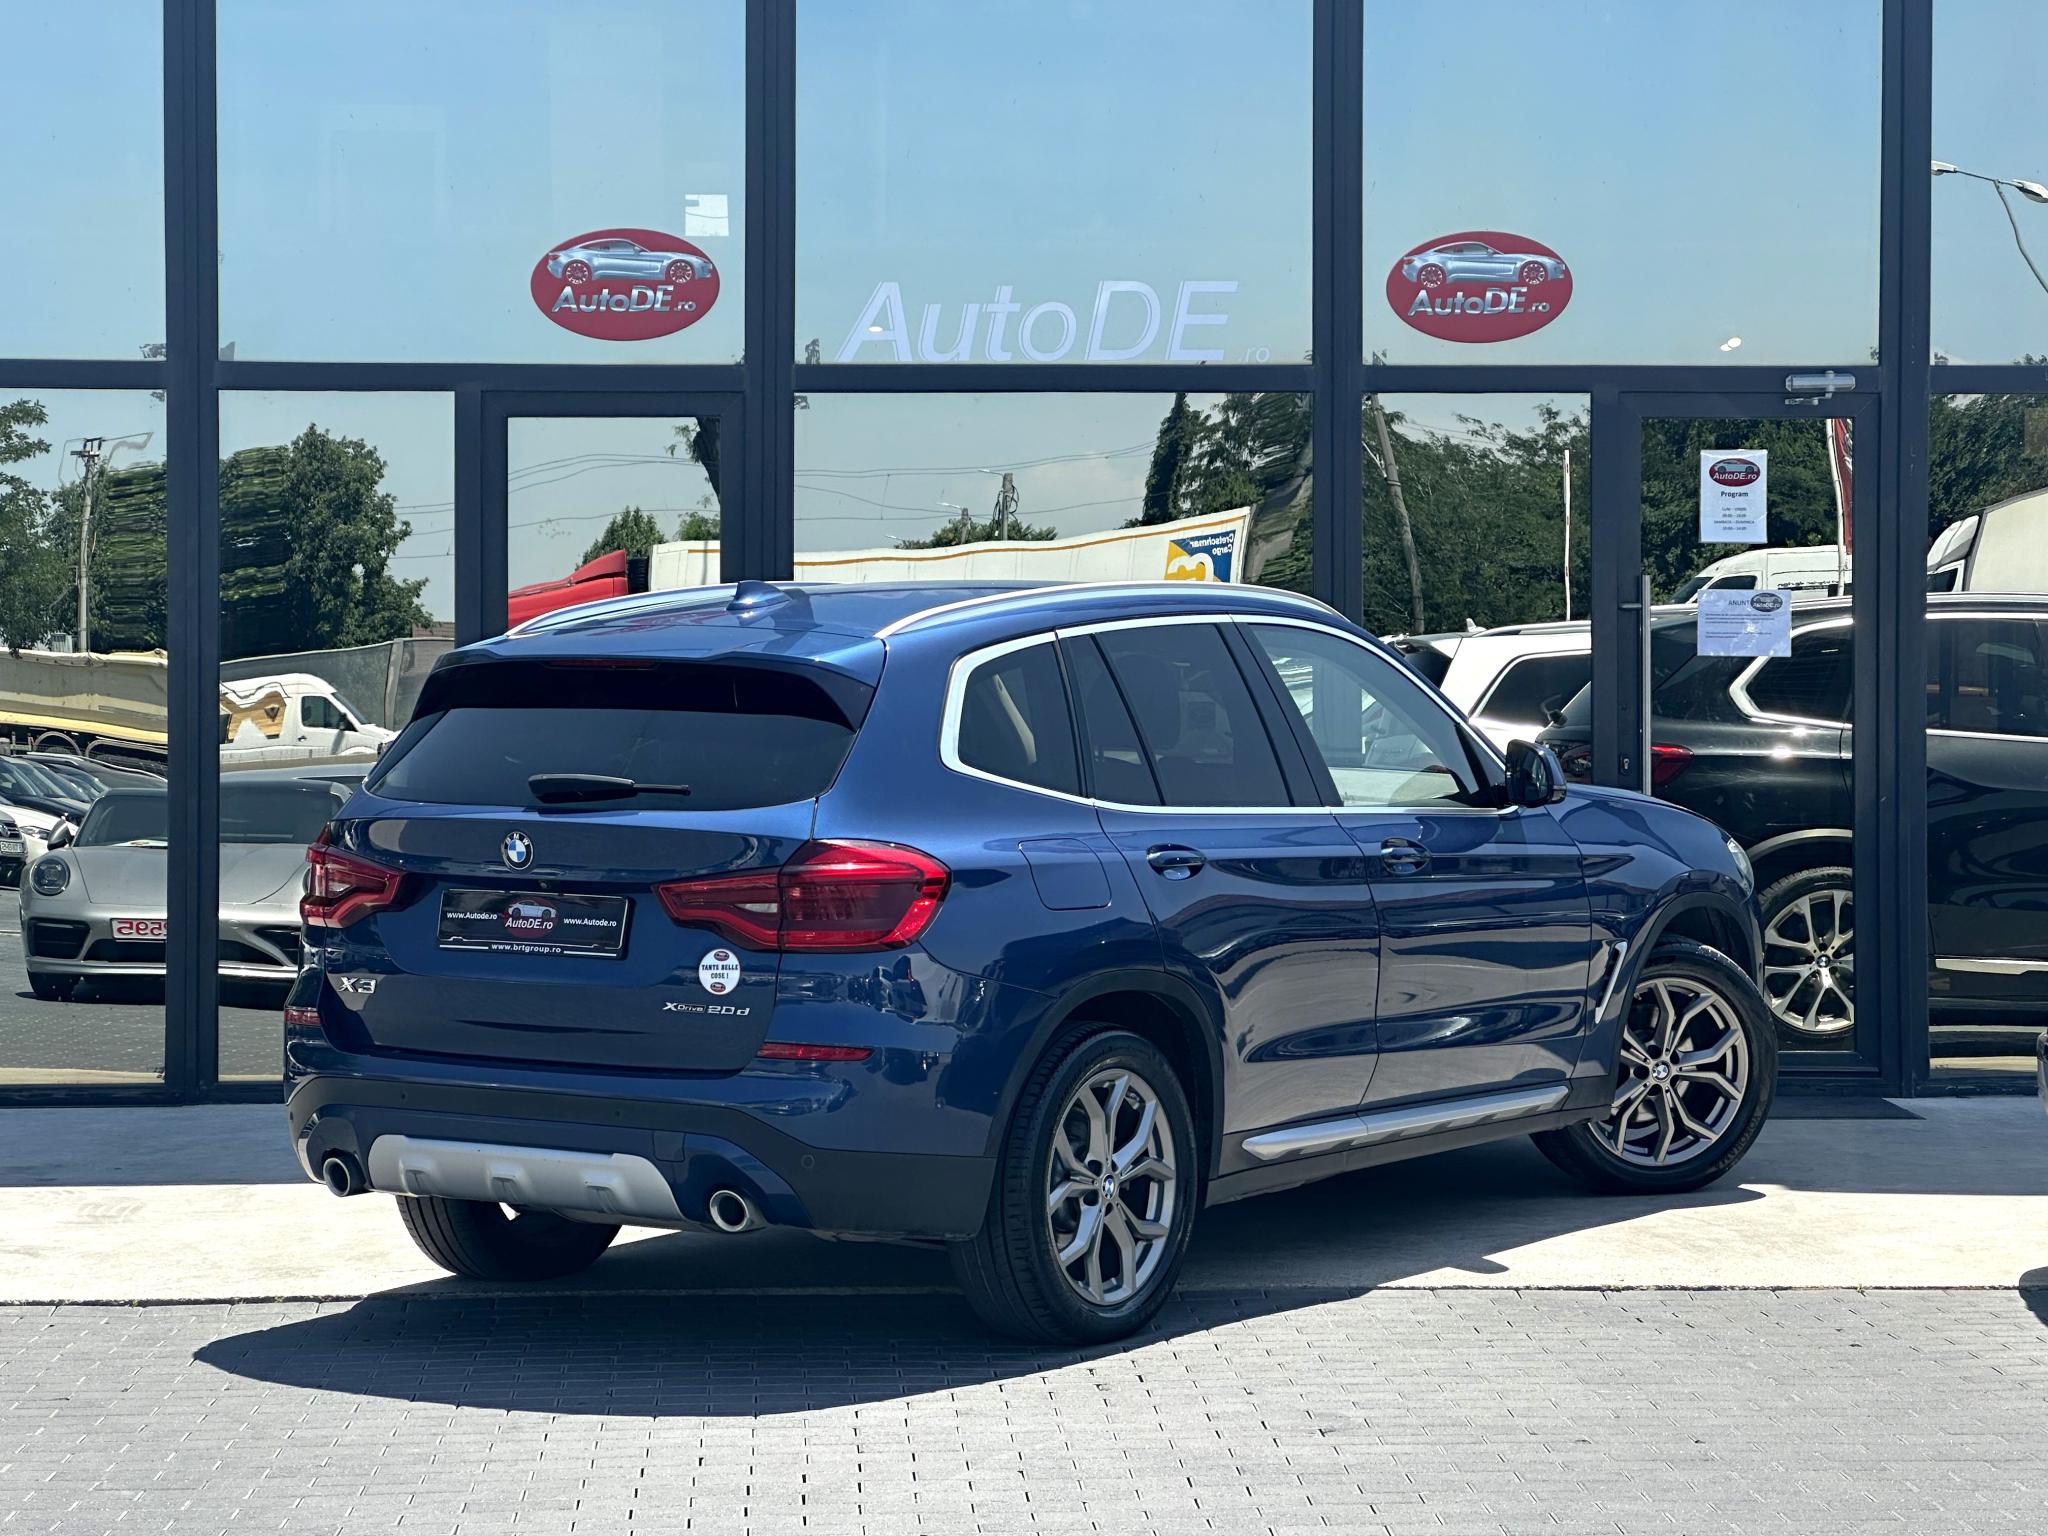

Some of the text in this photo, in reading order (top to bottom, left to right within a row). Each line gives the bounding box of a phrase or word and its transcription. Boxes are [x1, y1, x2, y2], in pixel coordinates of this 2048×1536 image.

[1712, 472, 1757, 480] AutoDE.ro
[1720, 490, 1749, 499] Program
[446, 911, 498, 920] www.Autode.ro
[504, 917, 554, 930] AutoDE.ro
[563, 917, 617, 927] www.Autode.ro
[491, 943, 562, 954] www.brtgroup.ro
[337, 976, 377, 994] X3
